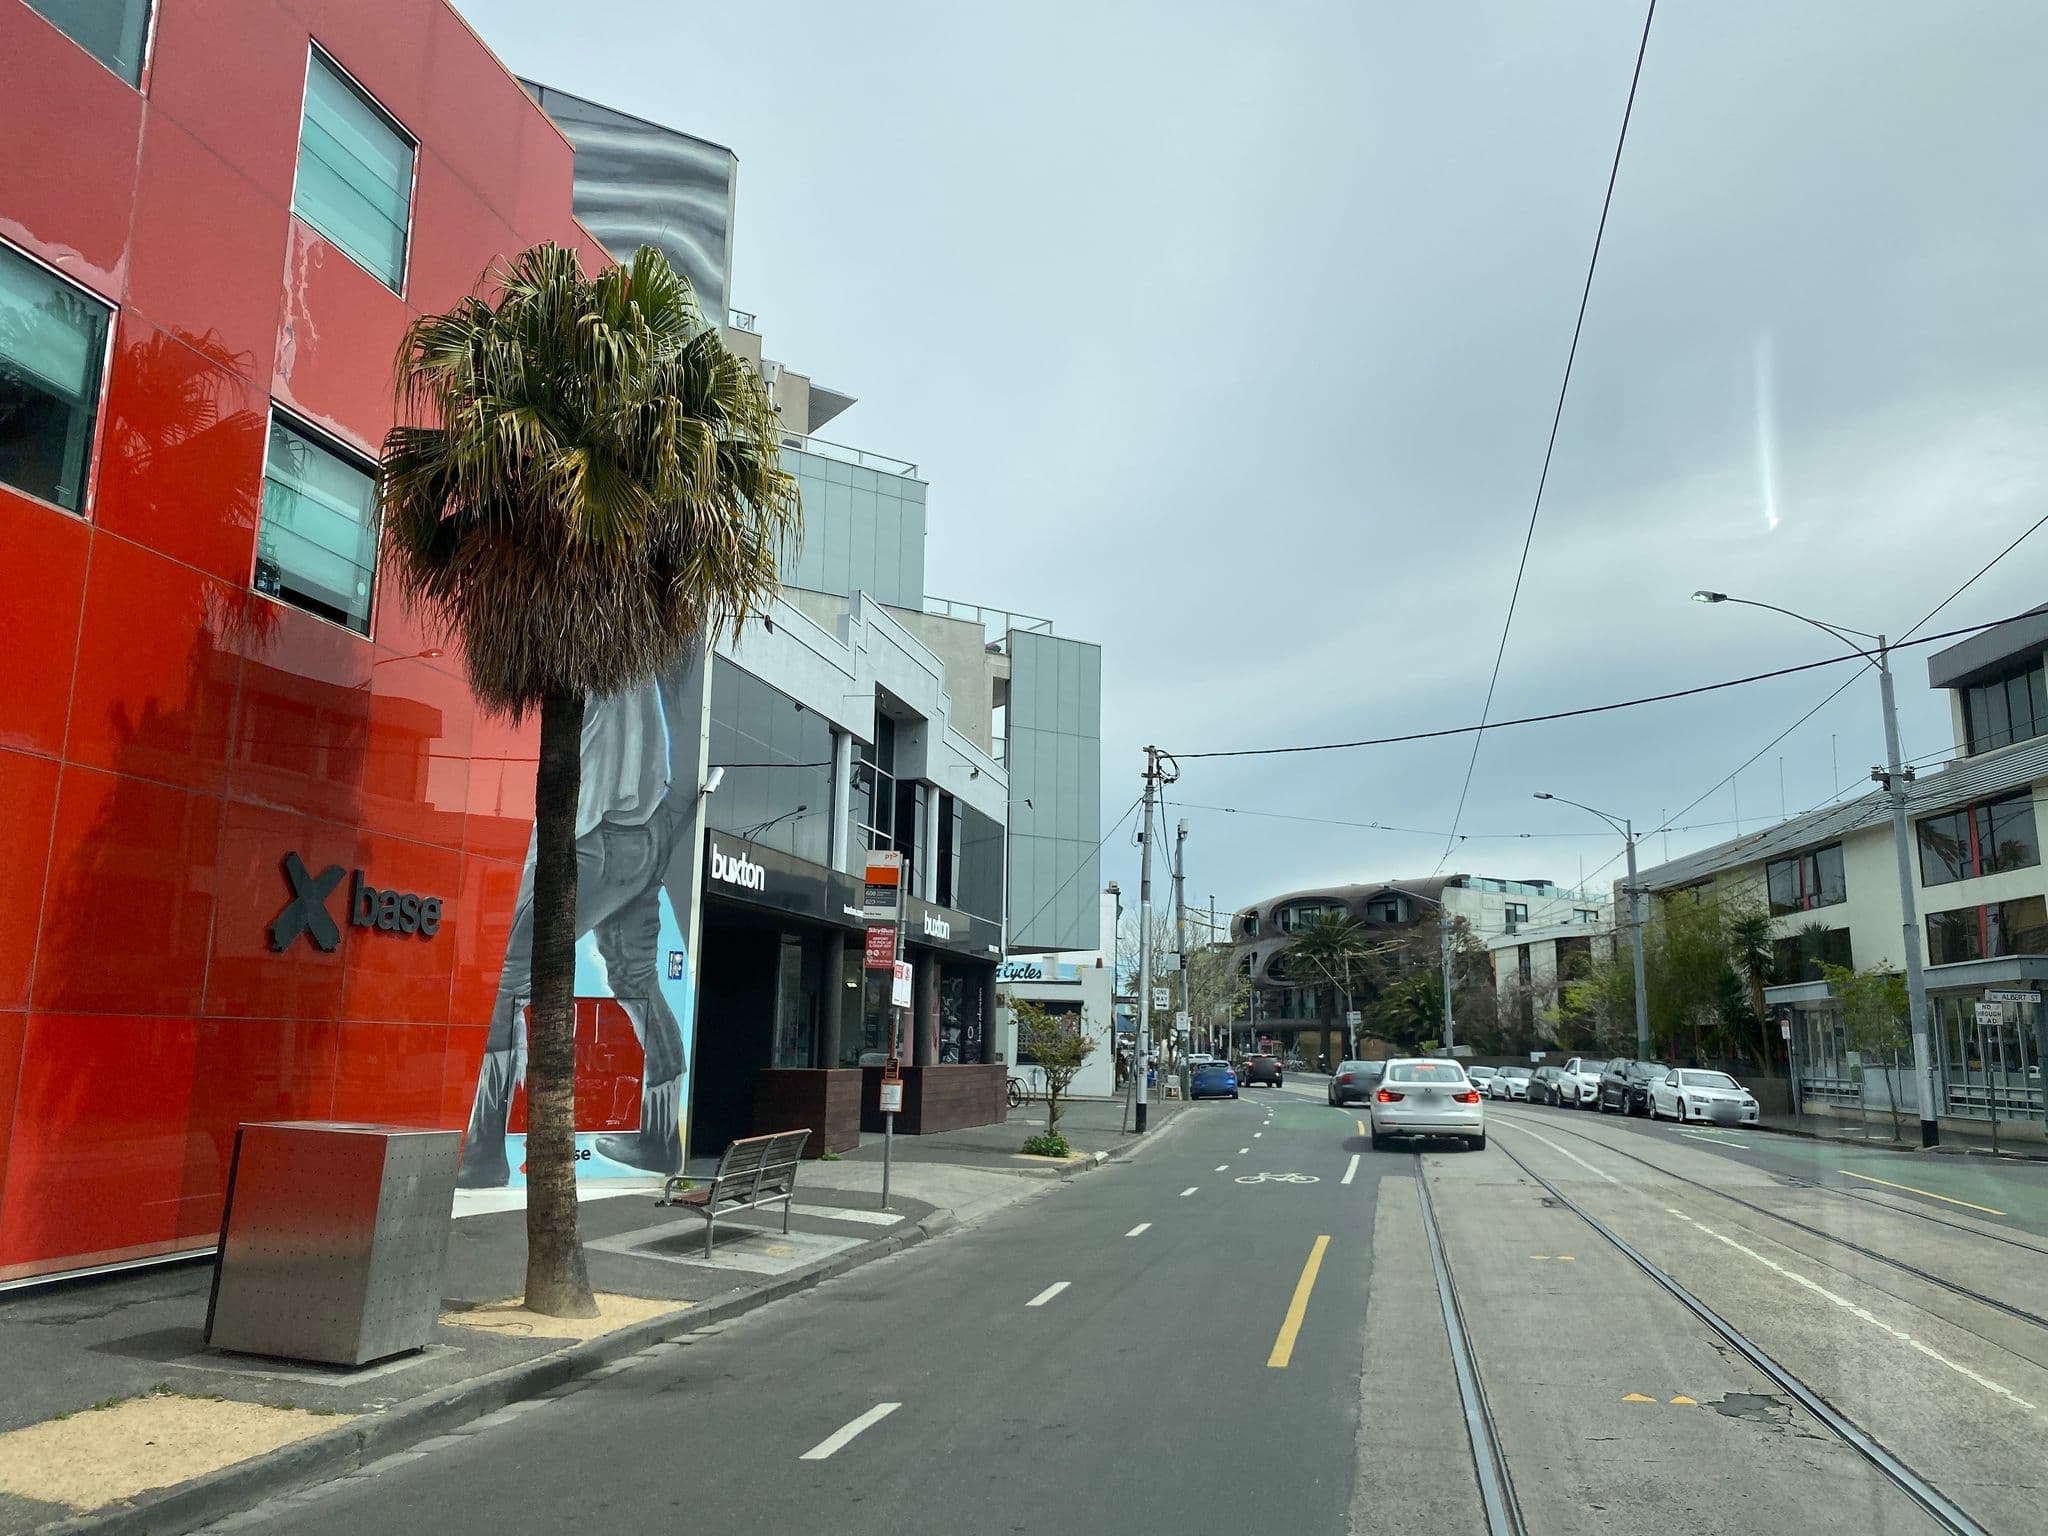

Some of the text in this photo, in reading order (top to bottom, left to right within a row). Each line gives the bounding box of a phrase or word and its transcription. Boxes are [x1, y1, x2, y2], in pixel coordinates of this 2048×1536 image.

[711, 843, 765, 891] buxton
[350, 868, 443, 937] base
[924, 909, 950, 940] buxton
[1004, 962, 1042, 981] Cycles
[2001, 993, 2027, 1001] ALBERT
[574, 1148, 591, 1161] se
